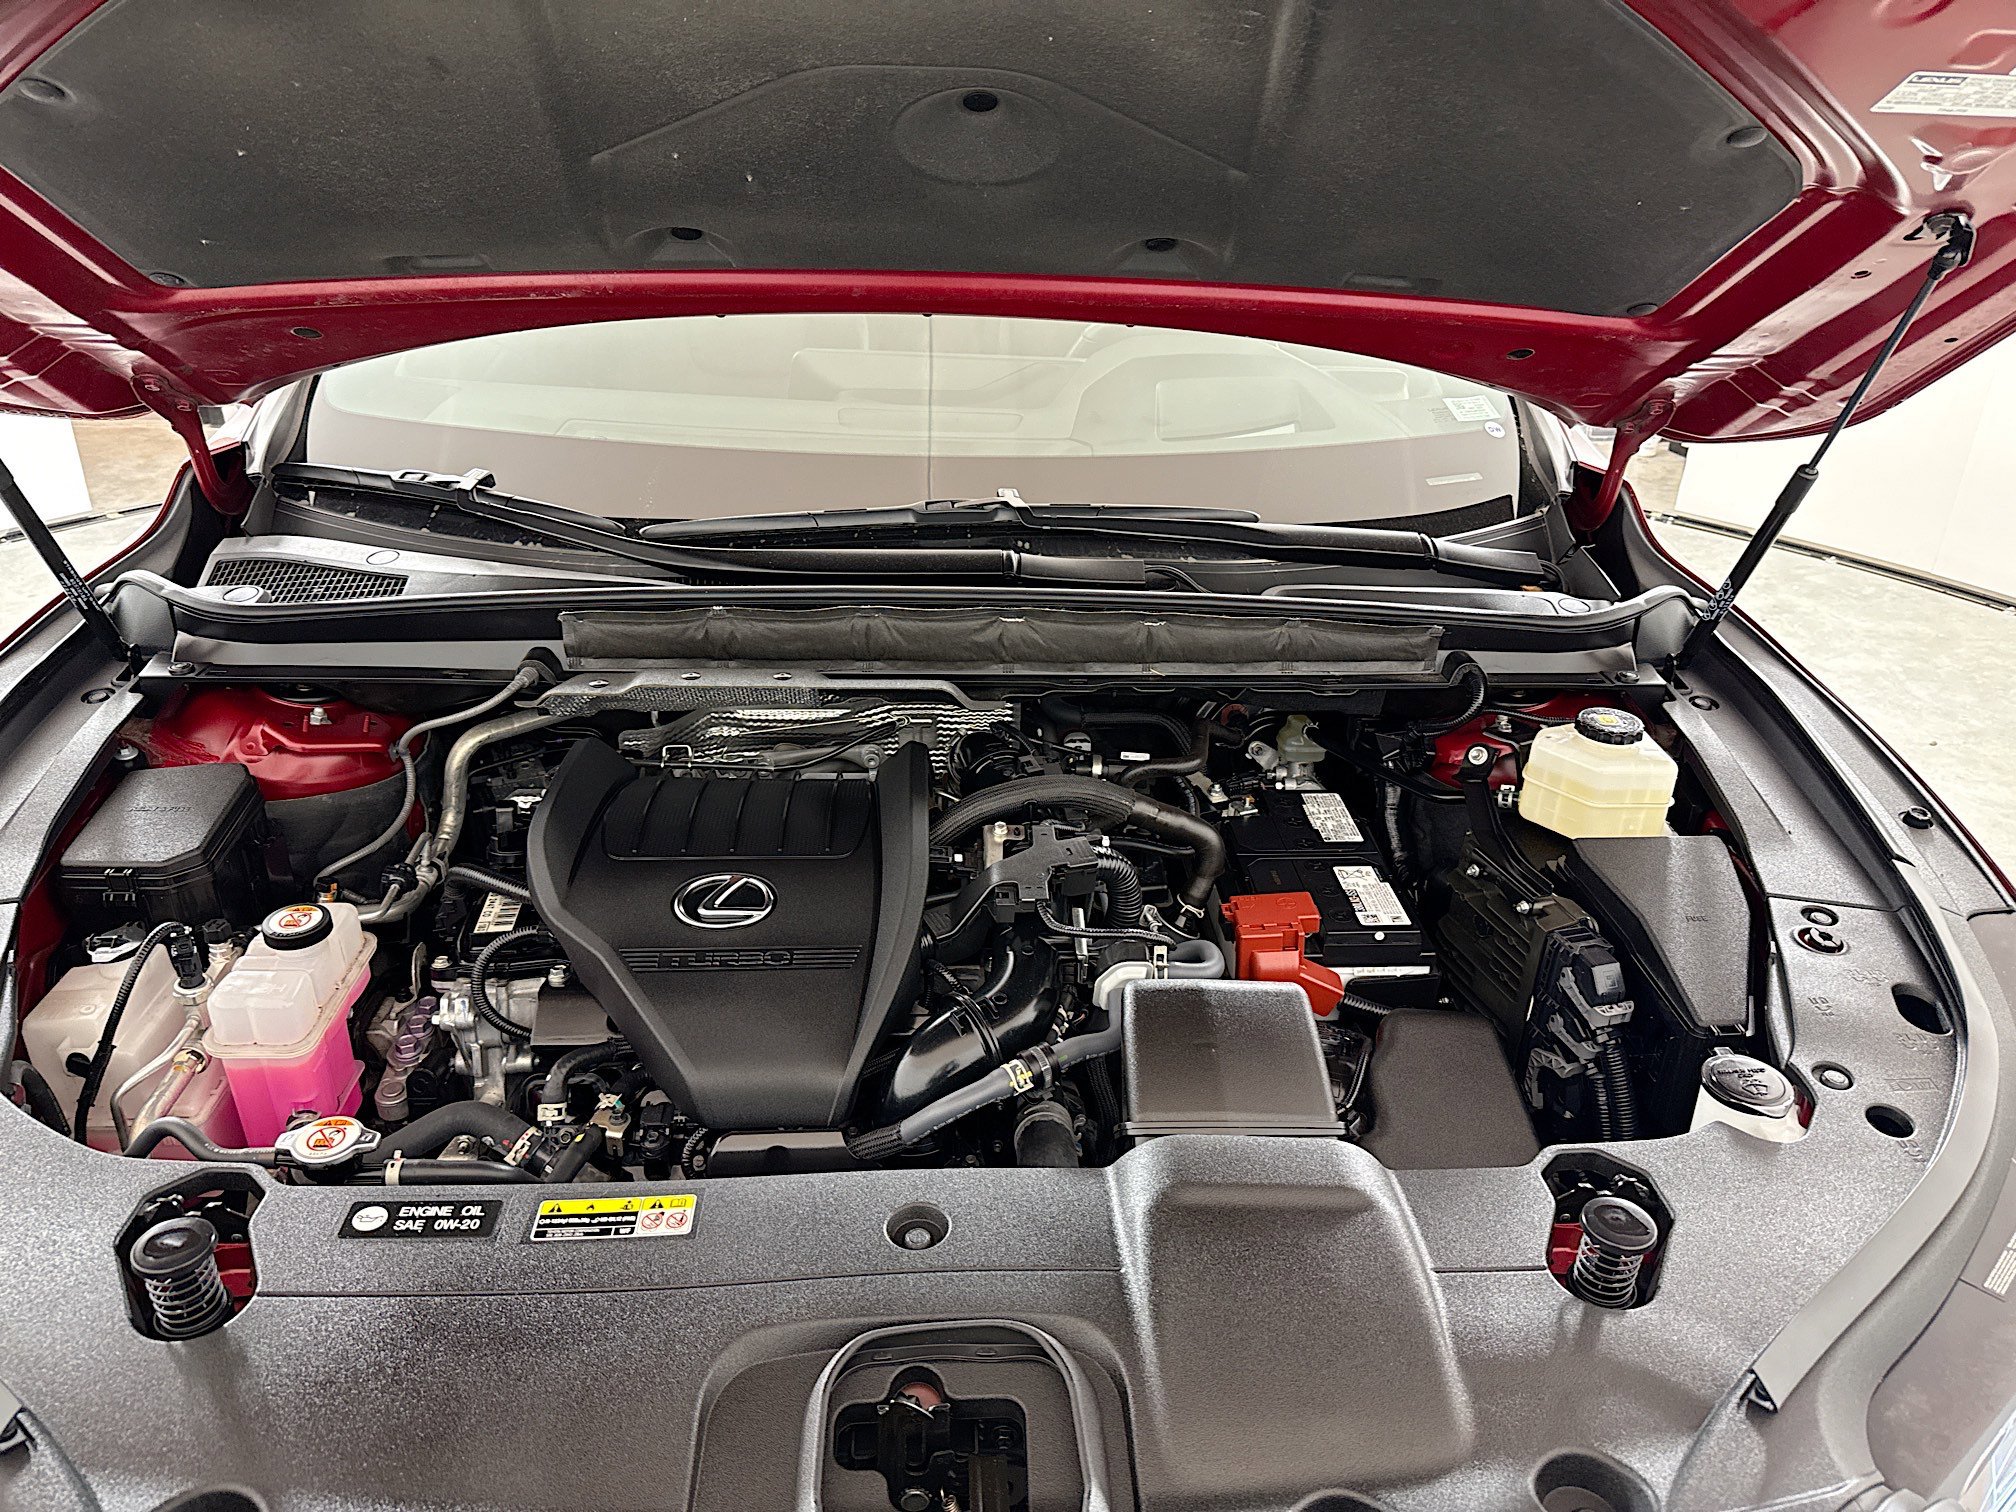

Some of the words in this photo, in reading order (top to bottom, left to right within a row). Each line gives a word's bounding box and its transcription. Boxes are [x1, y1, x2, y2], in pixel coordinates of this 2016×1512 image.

[662, 950, 792, 967] TURBO
[398, 1206, 454, 1217] ENGINE
[461, 1206, 486, 1216] OIL
[393, 1219, 426, 1231] SAE
[433, 1219, 480, 1230] 0W-20
